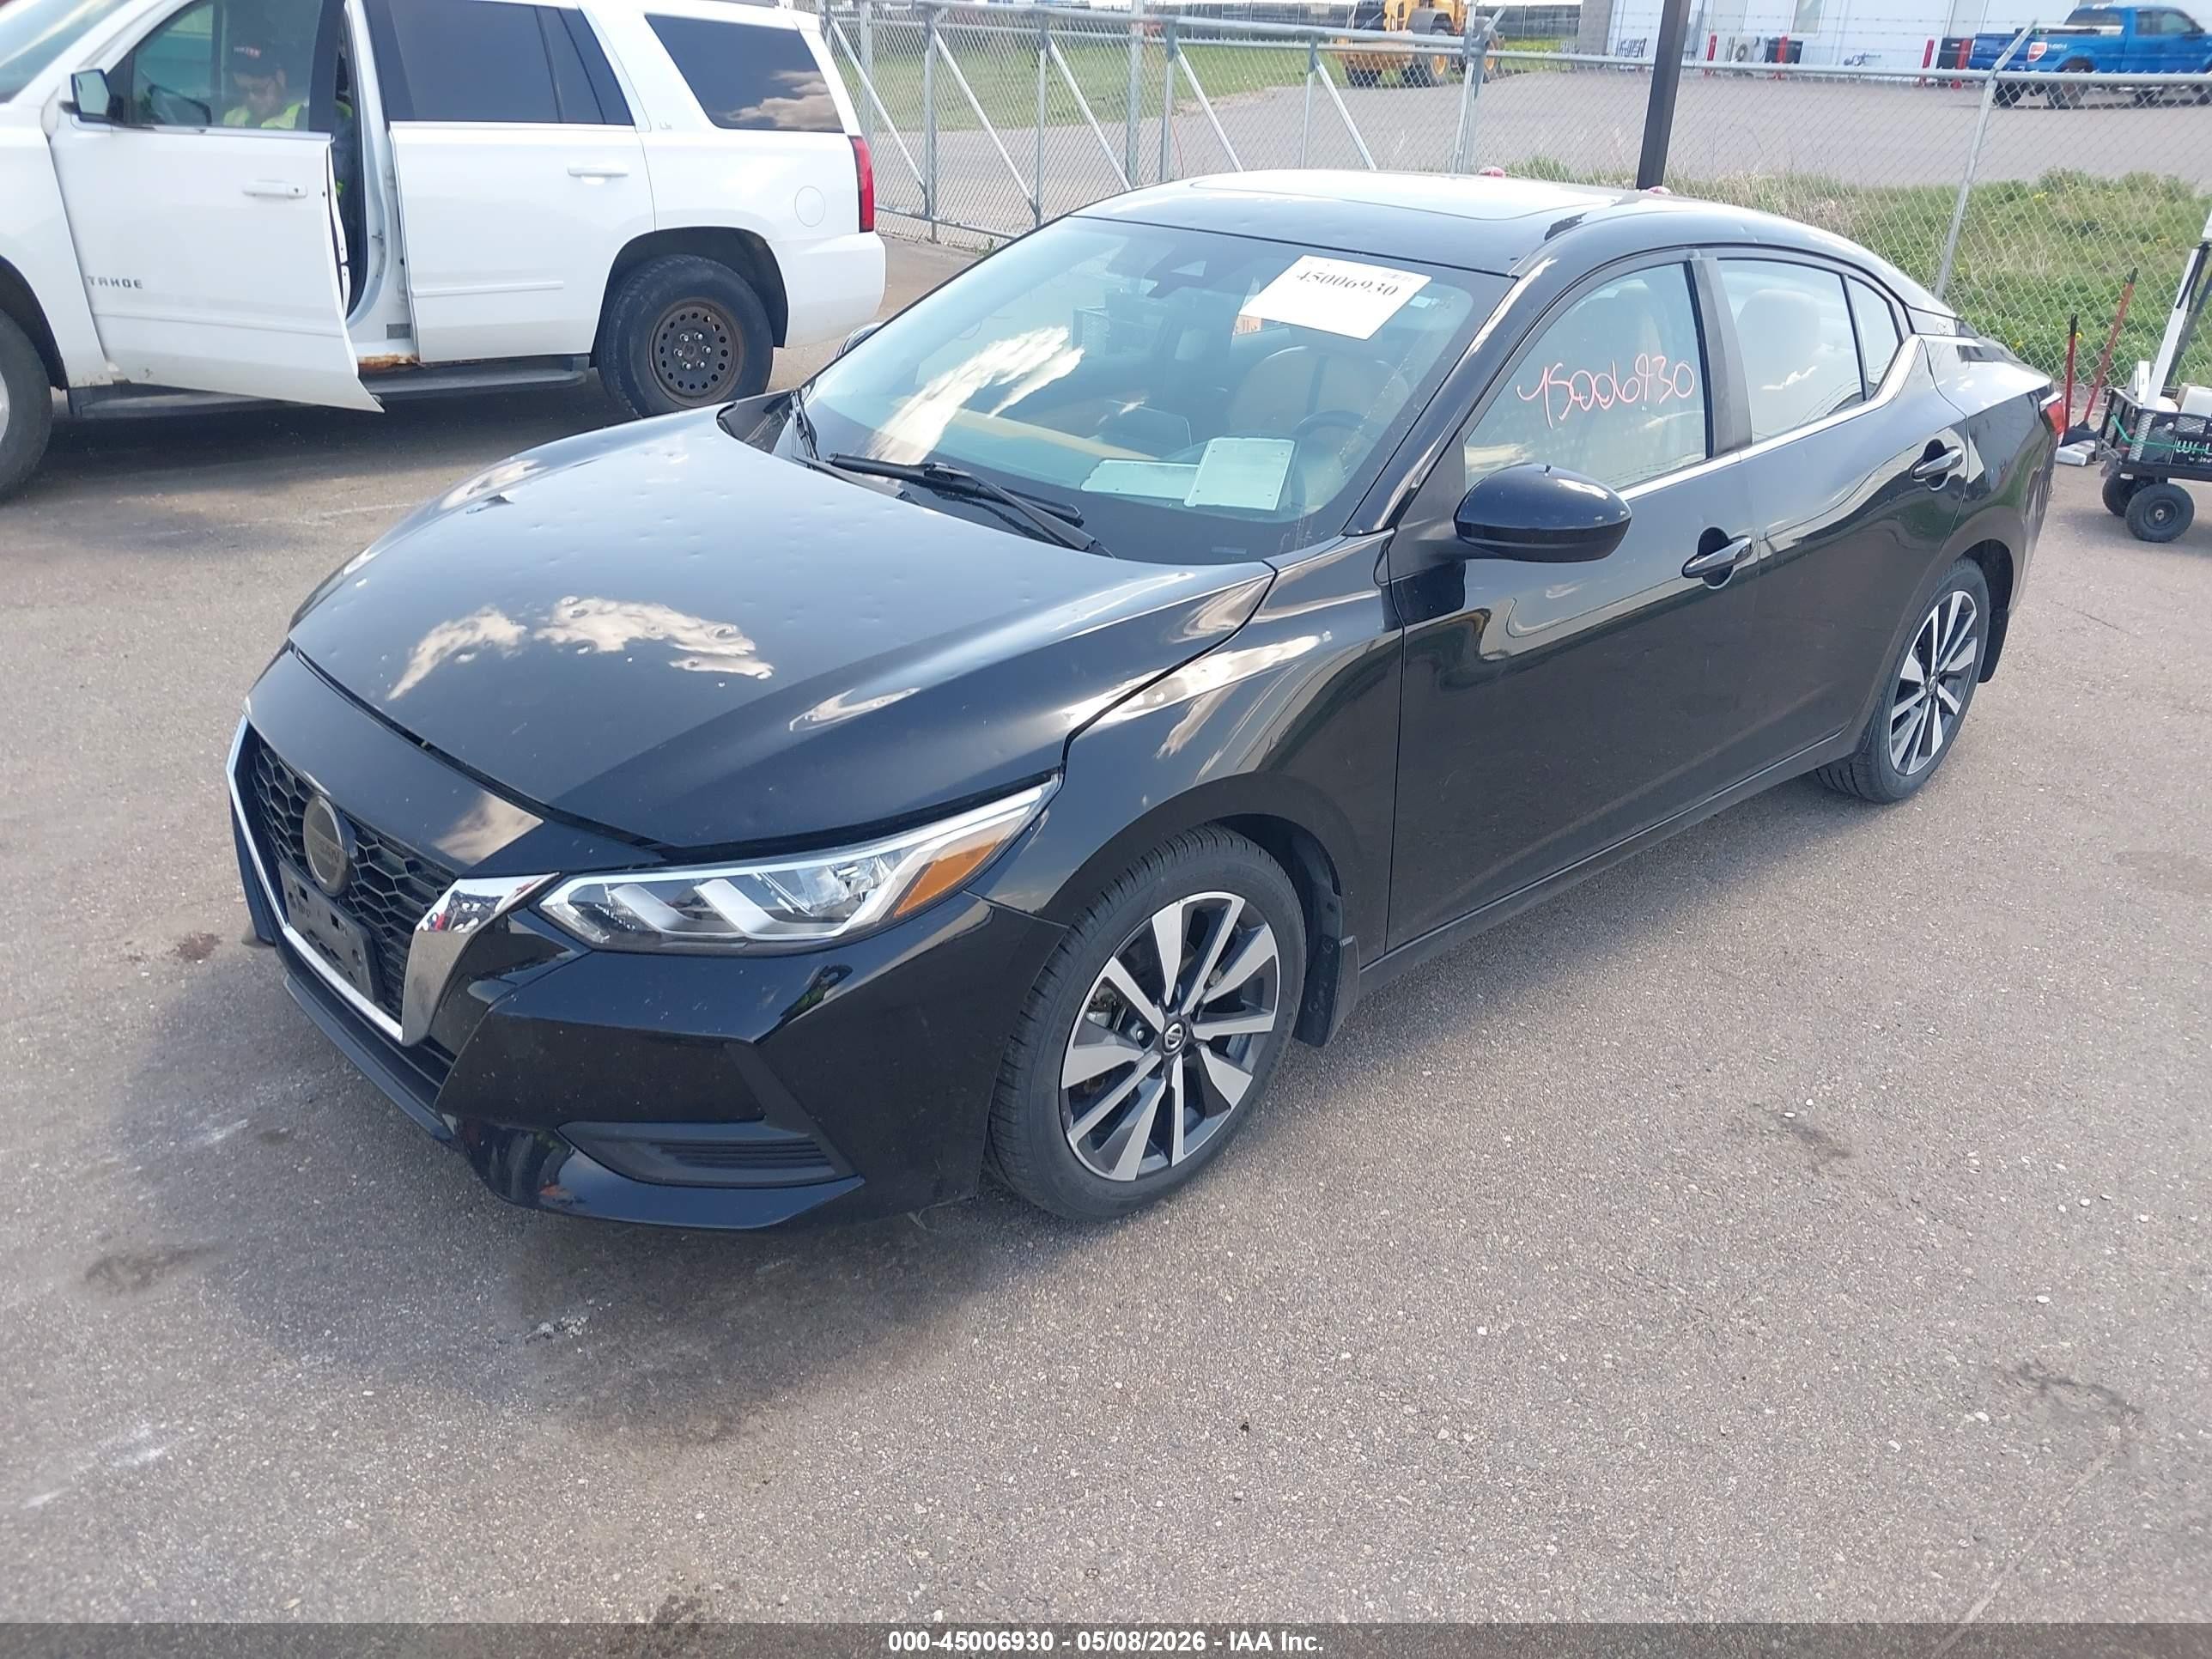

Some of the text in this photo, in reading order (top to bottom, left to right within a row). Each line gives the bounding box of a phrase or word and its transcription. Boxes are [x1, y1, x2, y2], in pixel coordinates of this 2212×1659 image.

[87, 276, 143, 289] TAHOE
[1297, 270, 1399, 296] 45006930
[1516, 353, 1695, 429] 45006930
